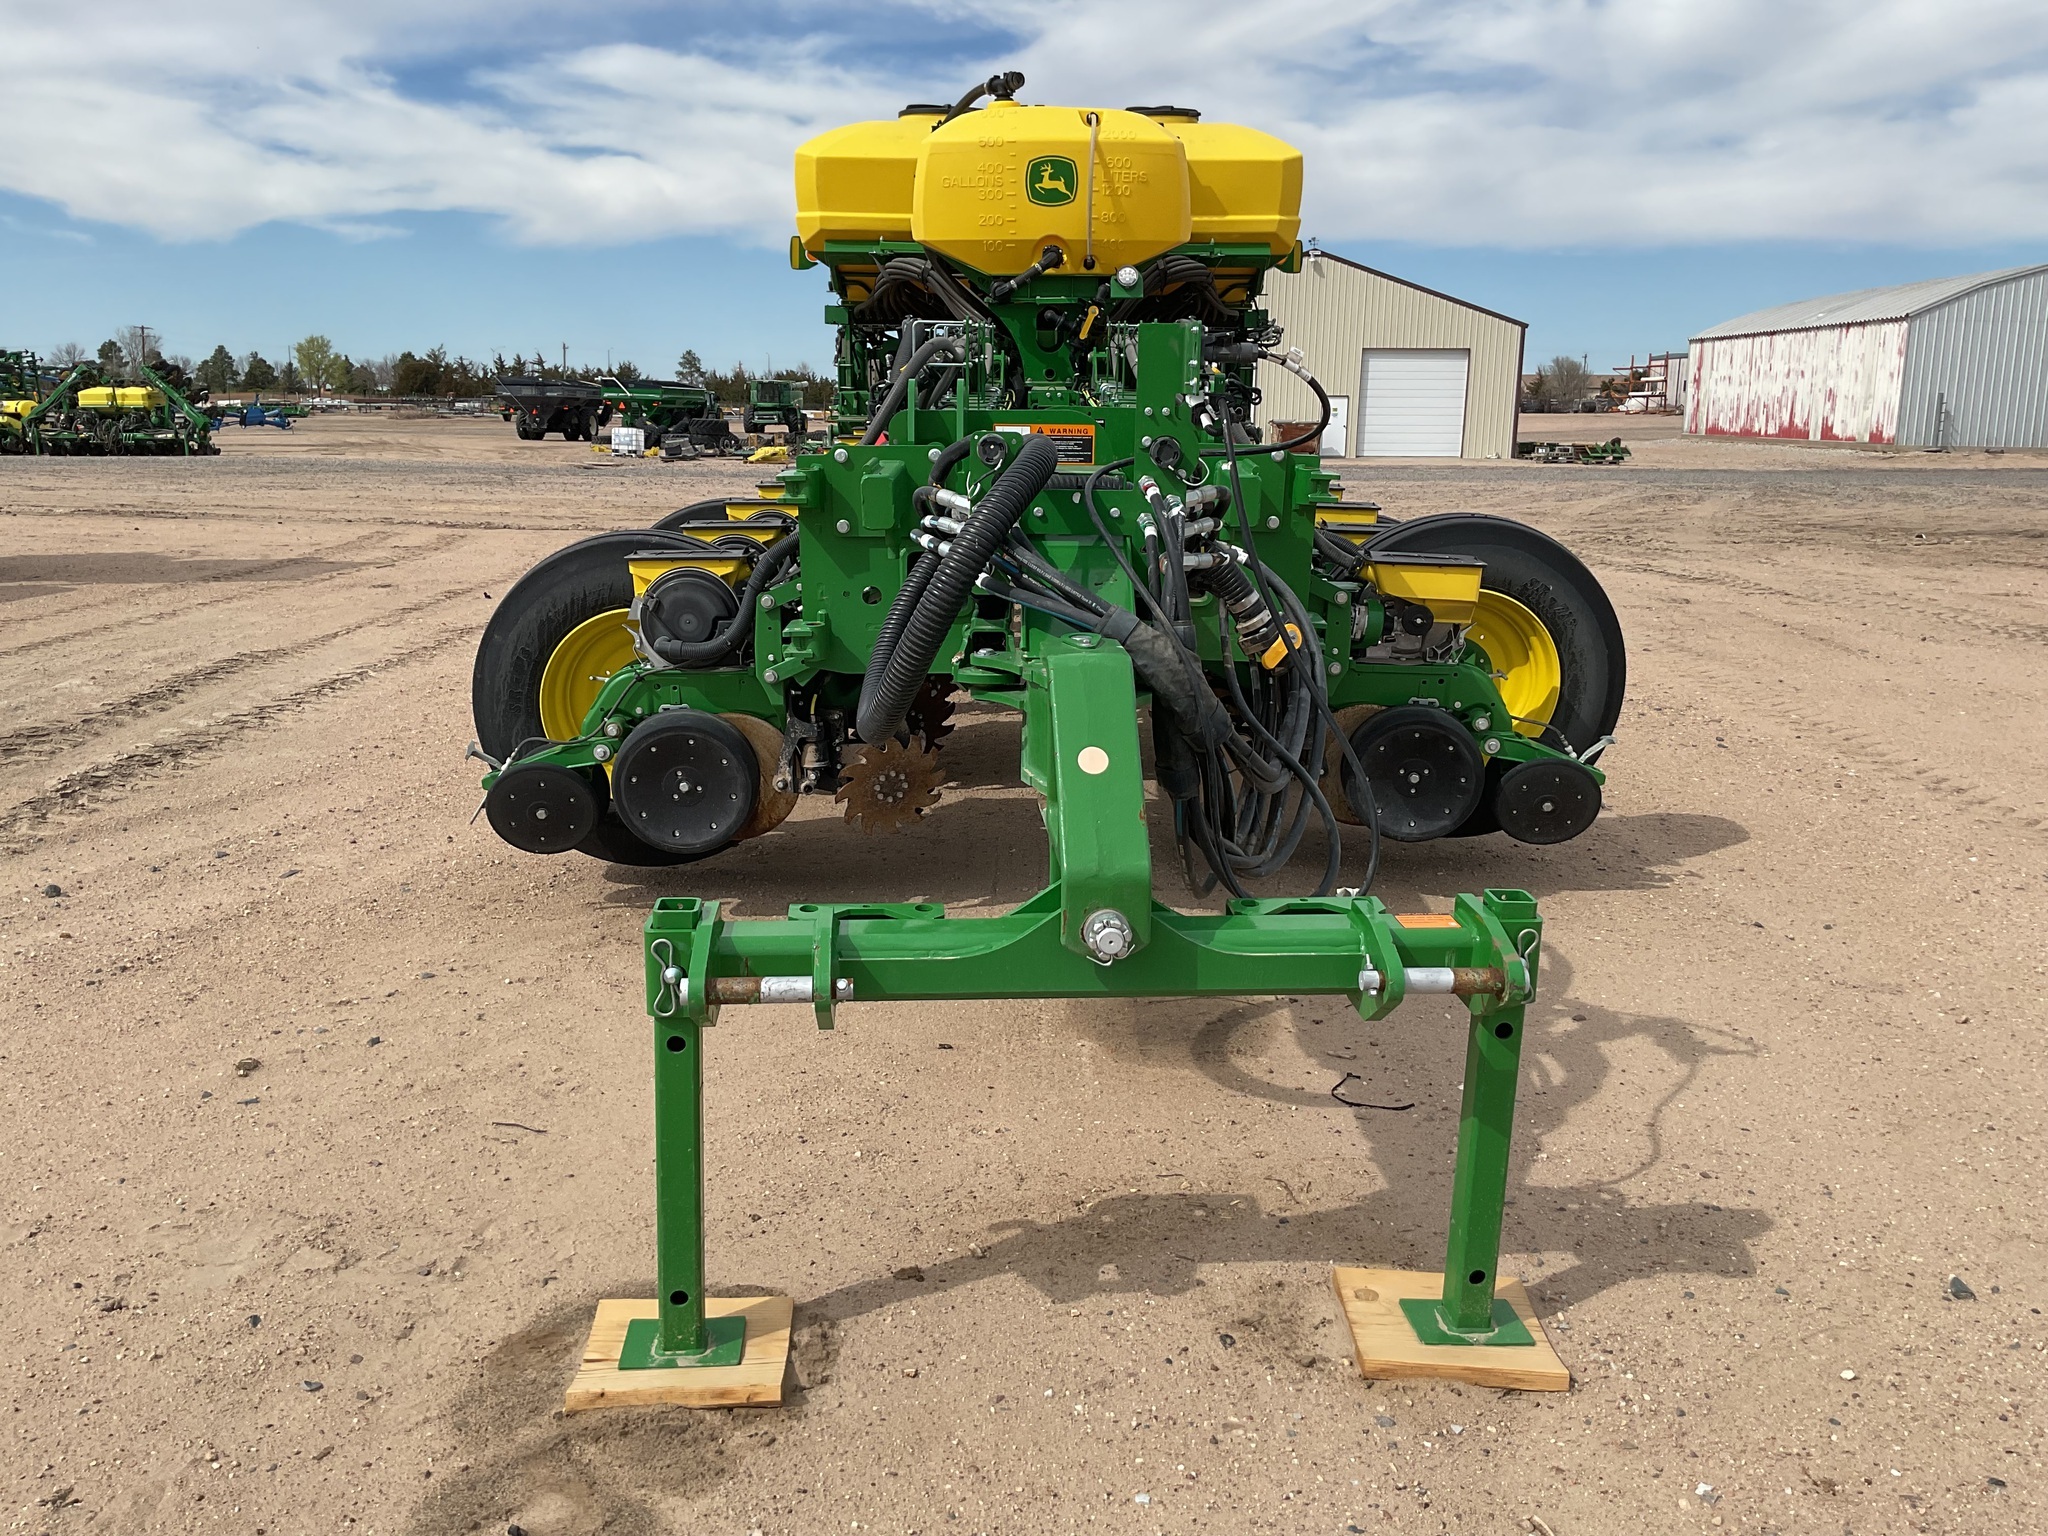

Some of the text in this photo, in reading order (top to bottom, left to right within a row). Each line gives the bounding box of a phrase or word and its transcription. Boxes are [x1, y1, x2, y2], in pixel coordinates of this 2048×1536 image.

[1102, 129, 1136, 140] 2000
[978, 136, 1004, 147] 500
[977, 162, 1003, 174] 400
[942, 175, 1003, 188] GALLONS
[978, 188, 1003, 200] 300
[1102, 184, 1131, 196] 1200
[978, 214, 1003, 226] 200
[1101, 211, 1126, 222] 800
[983, 240, 1003, 251] 100
[1049, 427, 1089, 435] WARNING
